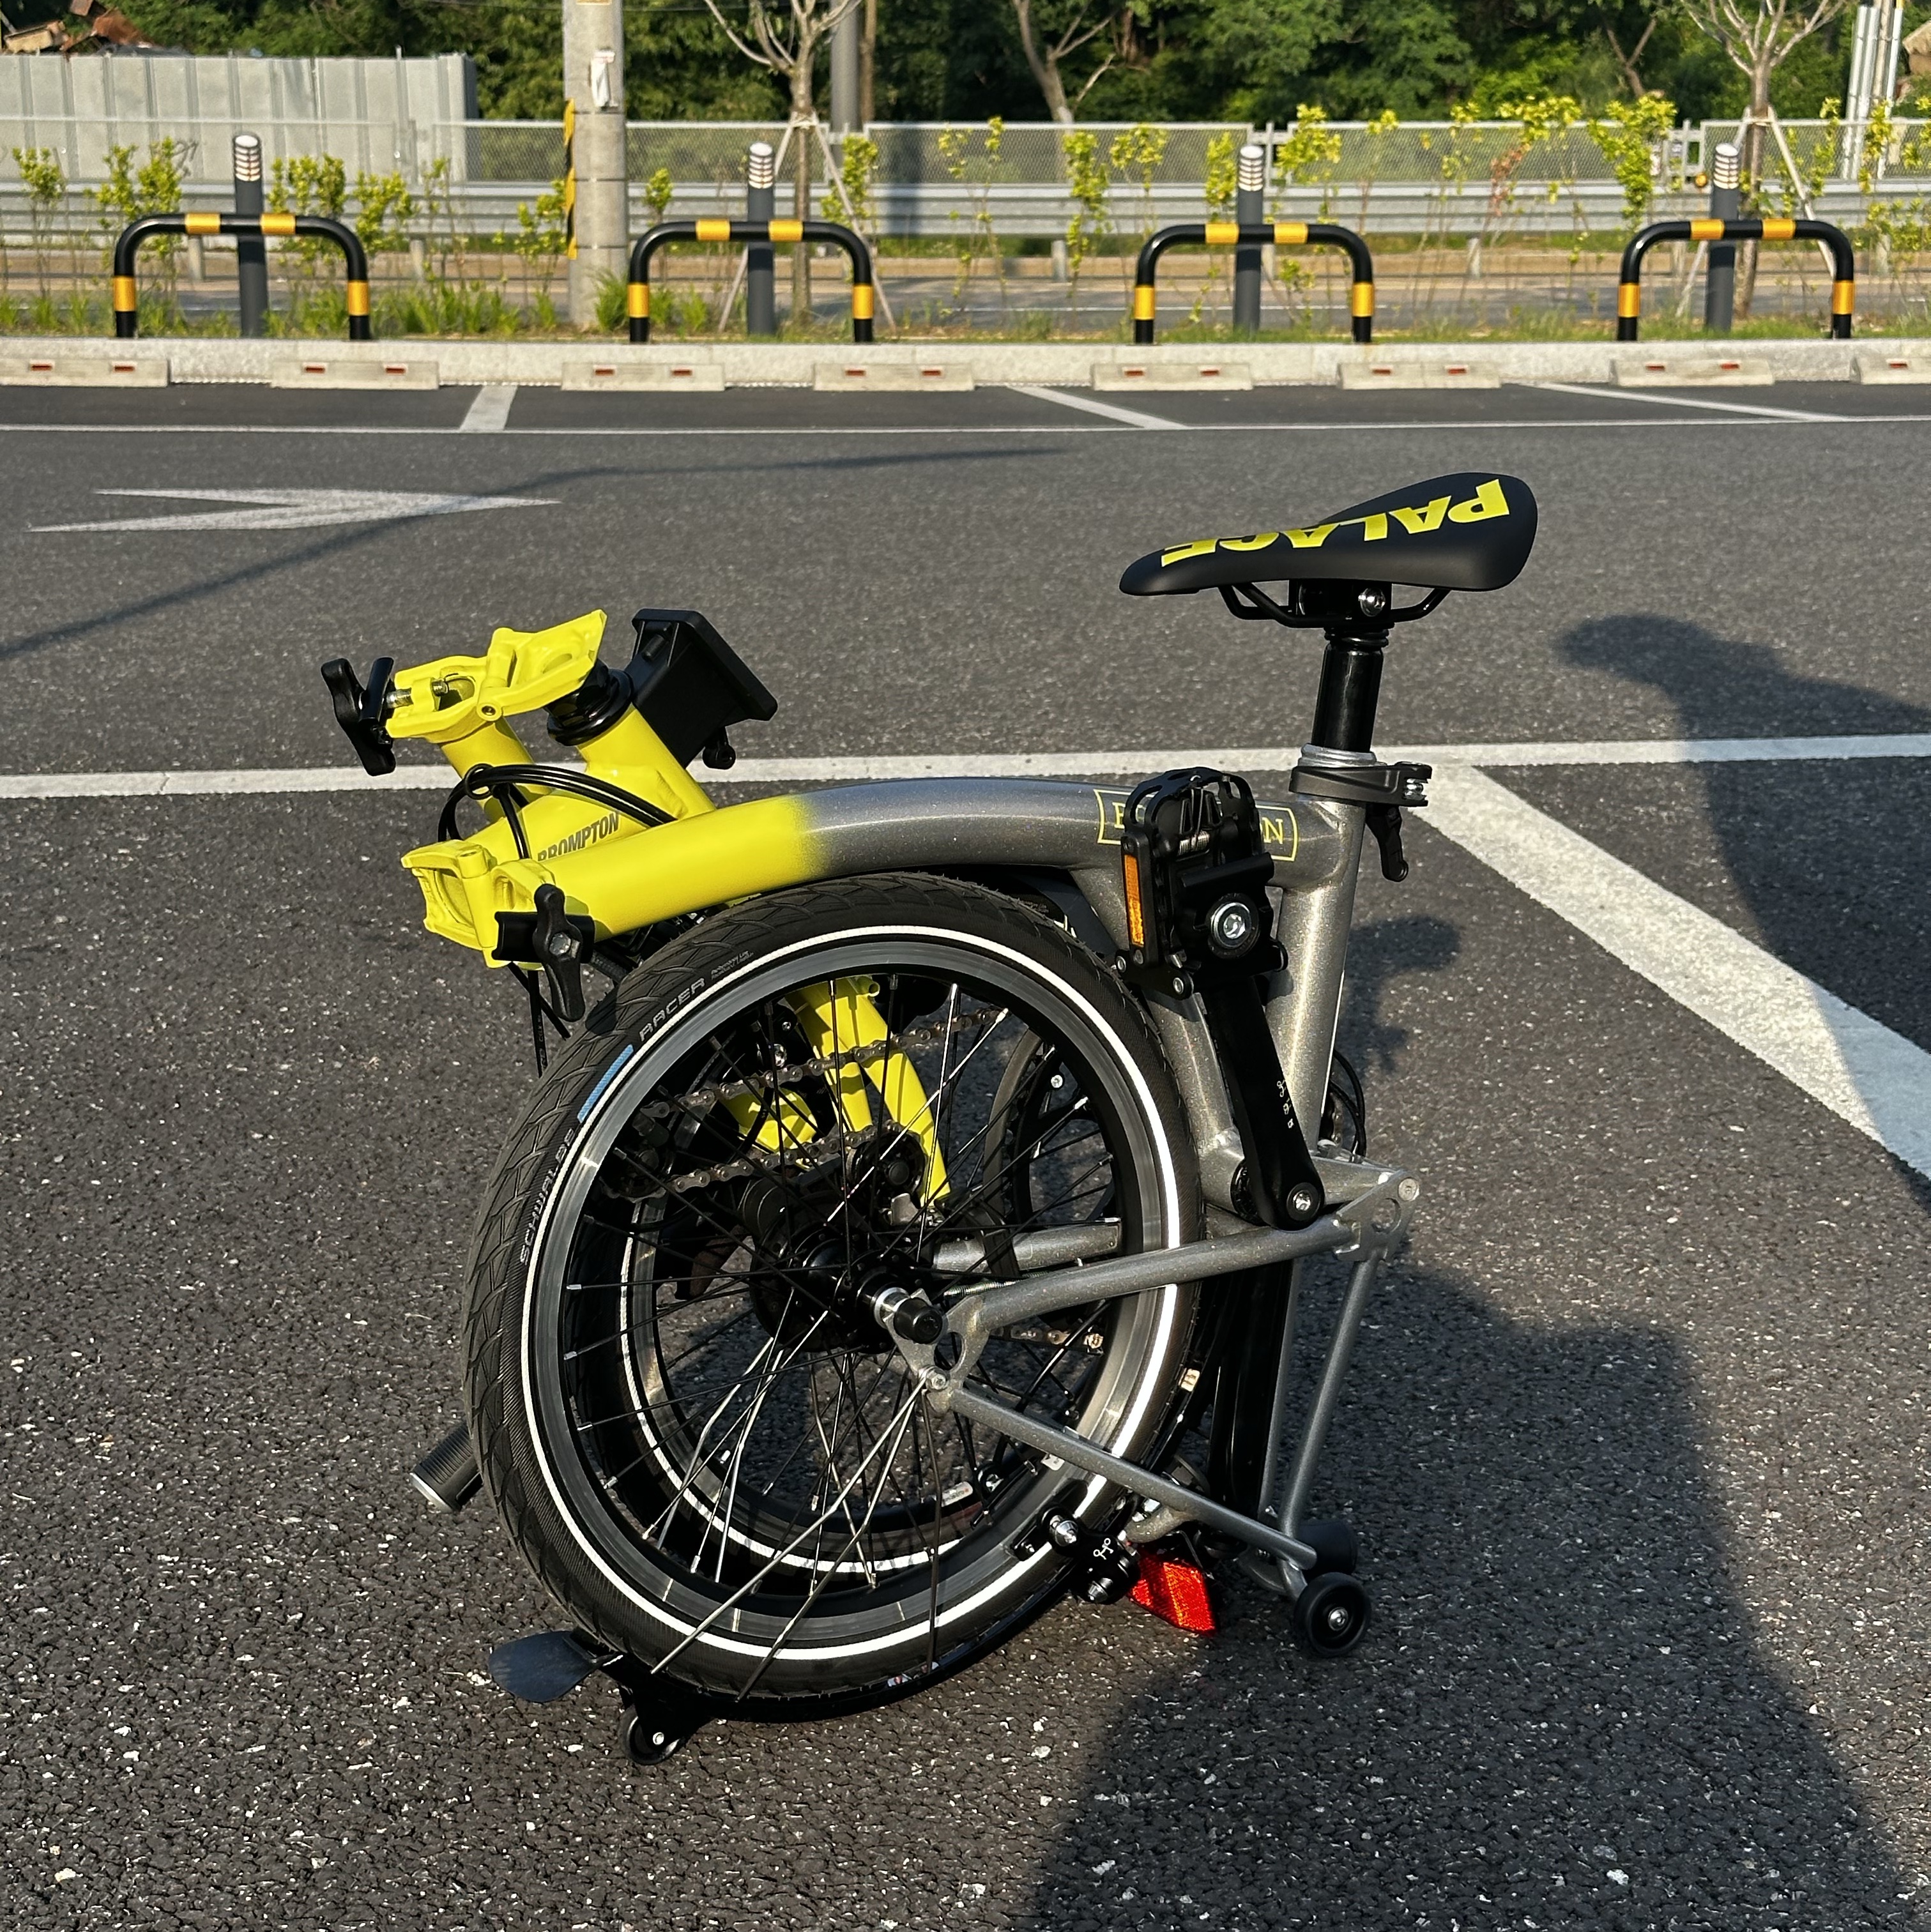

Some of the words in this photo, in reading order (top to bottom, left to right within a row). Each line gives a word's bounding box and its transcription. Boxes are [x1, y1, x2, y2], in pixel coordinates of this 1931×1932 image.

[537, 810, 619, 862] BROMPTON
[639, 978, 705, 1042] RACER
[520, 1128, 574, 1266] SCHWALBE
